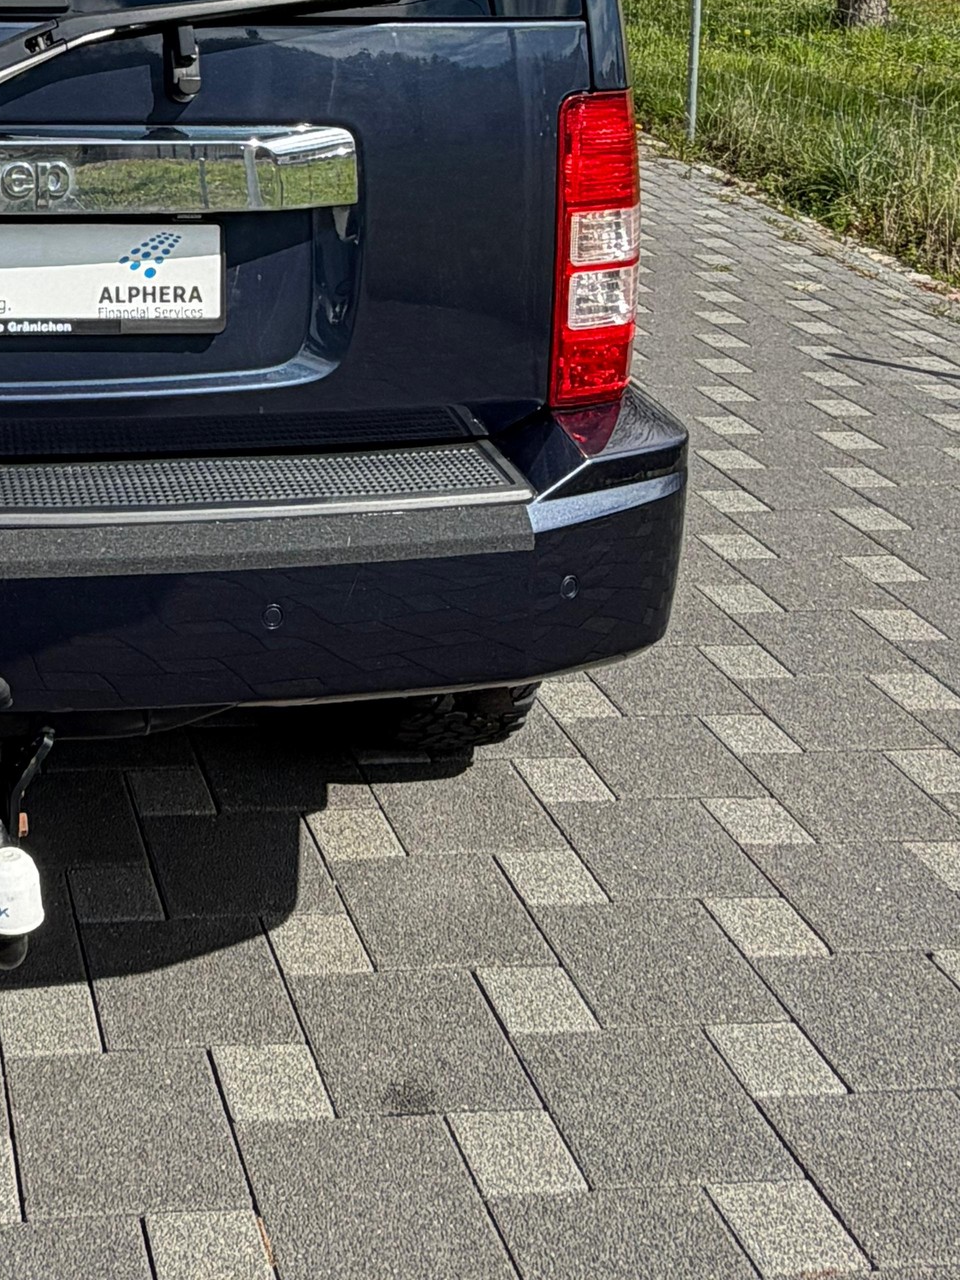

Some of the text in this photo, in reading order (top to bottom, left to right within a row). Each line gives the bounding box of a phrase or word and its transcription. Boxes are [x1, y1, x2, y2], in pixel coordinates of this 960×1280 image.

[98, 285, 203, 303] ALPHERA
[97, 306, 204, 319] Financial Services
[7, 321, 72, 333] Gränichen
